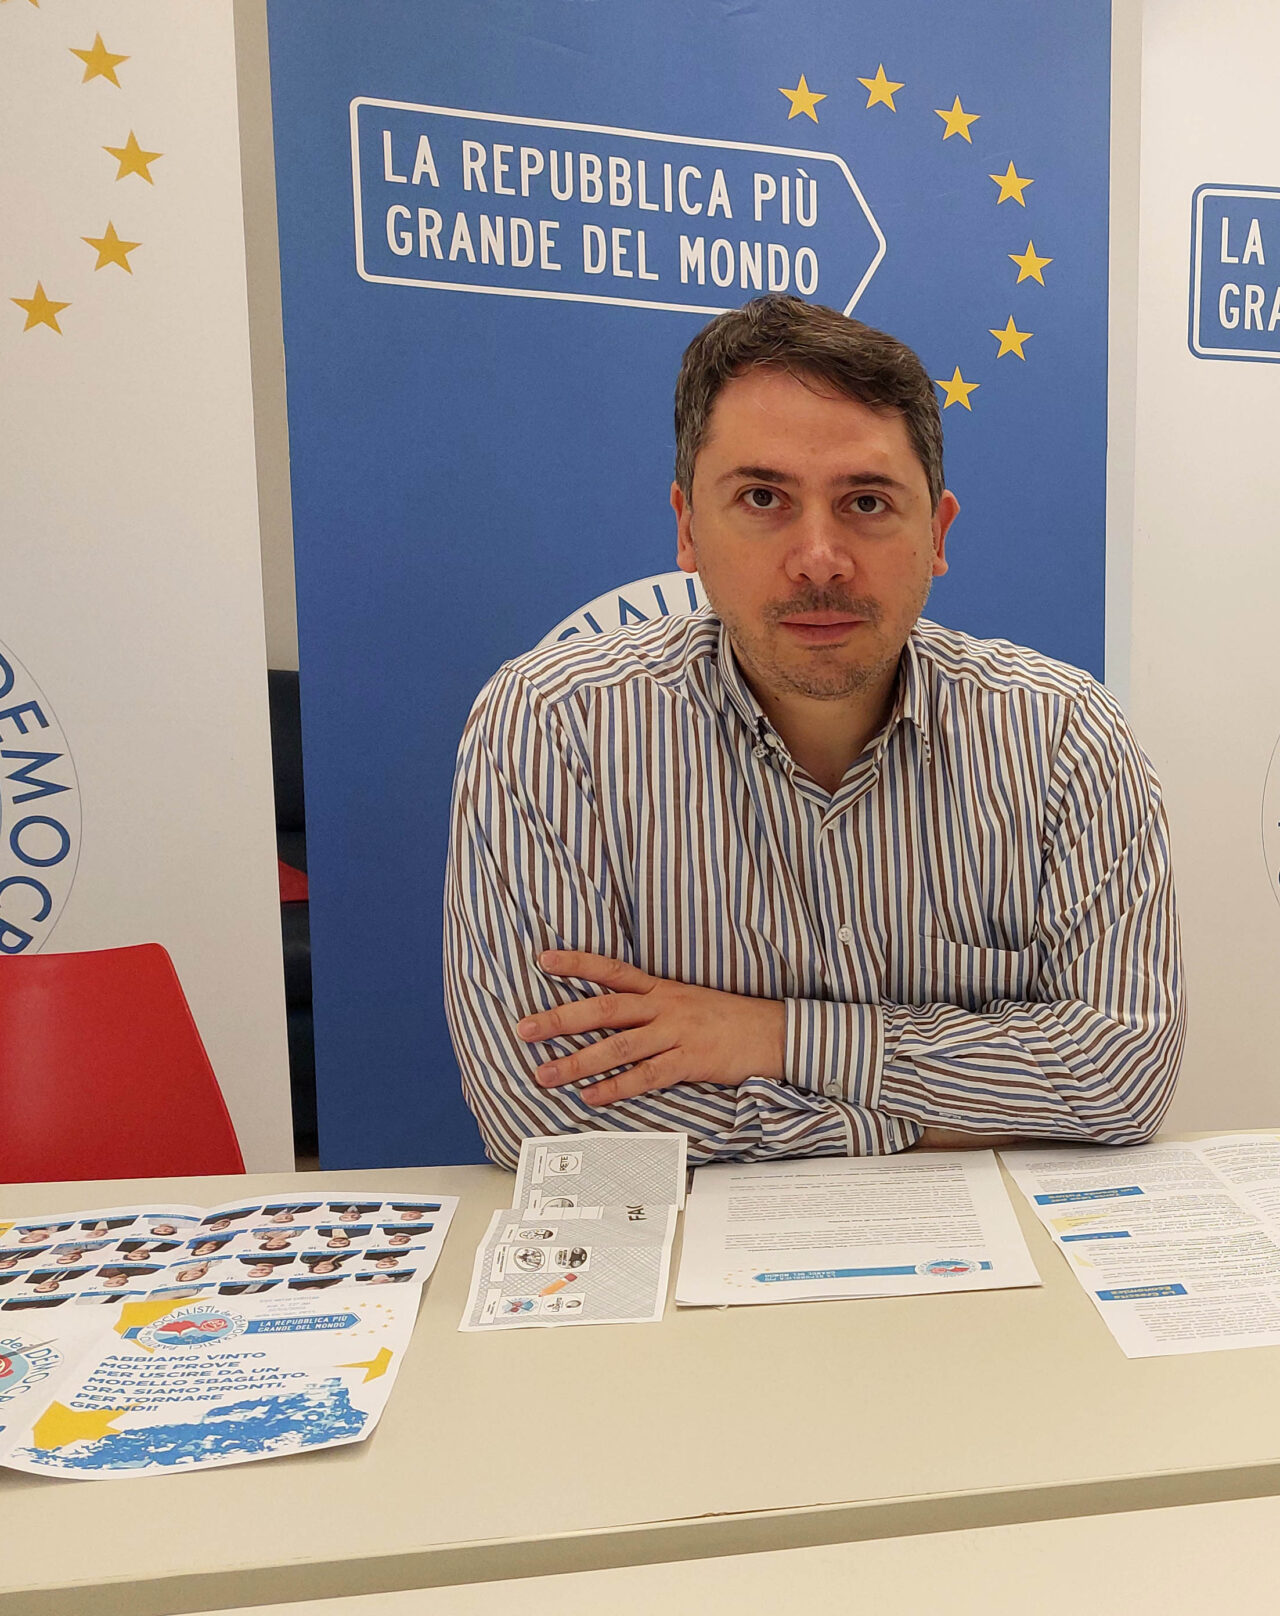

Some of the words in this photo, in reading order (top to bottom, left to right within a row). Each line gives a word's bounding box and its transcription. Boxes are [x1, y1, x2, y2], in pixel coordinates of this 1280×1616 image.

[382, 130, 440, 188] LA
[462, 140, 733, 219] REPUBBLICA
[754, 167, 818, 228] PIÙ
[1220, 217, 1265, 266] LA
[386, 204, 562, 271] GRANDE
[583, 224, 659, 281] DEL
[680, 235, 819, 296] MONDO
[274, 1316, 331, 1327] REPUBBLICA
[104, 1355, 200, 1363] ABBIAMO
[206, 1352, 267, 1360] VINTO
[99, 1362, 167, 1371] MOLTE
[171, 1361, 241, 1370] PROVE
[93, 1369, 133, 1378] PER
[139, 1369, 213, 1379] USCIRE
[217, 1368, 245, 1376] DA
[87, 1377, 188, 1387] MODELLO
[82, 1385, 127, 1394] ORA
[132, 1386, 201, 1395] SIAMO
[75, 1392, 118, 1403] PER
[123, 1393, 225, 1404] TORNARE
